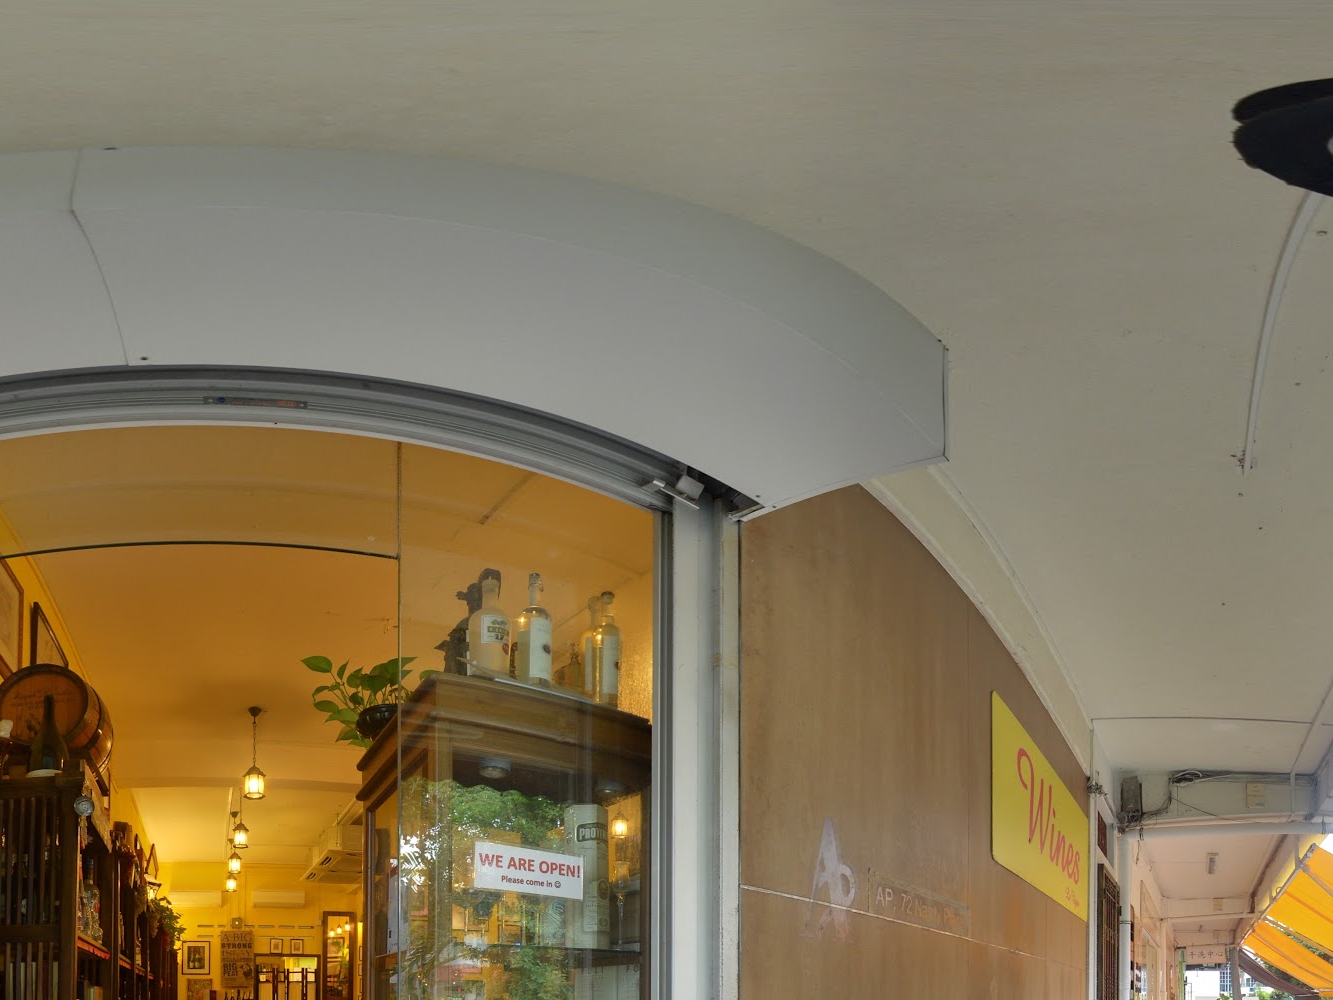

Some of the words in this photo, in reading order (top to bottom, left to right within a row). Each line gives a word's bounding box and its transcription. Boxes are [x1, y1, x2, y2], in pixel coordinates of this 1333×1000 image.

[1016, 747, 1081, 885] Wines
[479, 852, 504, 868] WE
[507, 856, 535, 872] ARE
[539, 860, 581, 879] OPEN!
[501, 875, 524, 885] Please
[526, 879, 545, 887] come
[546, 880, 553, 888] in
[233, 933, 252, 942] BIG
[223, 962, 238, 970] BIG
